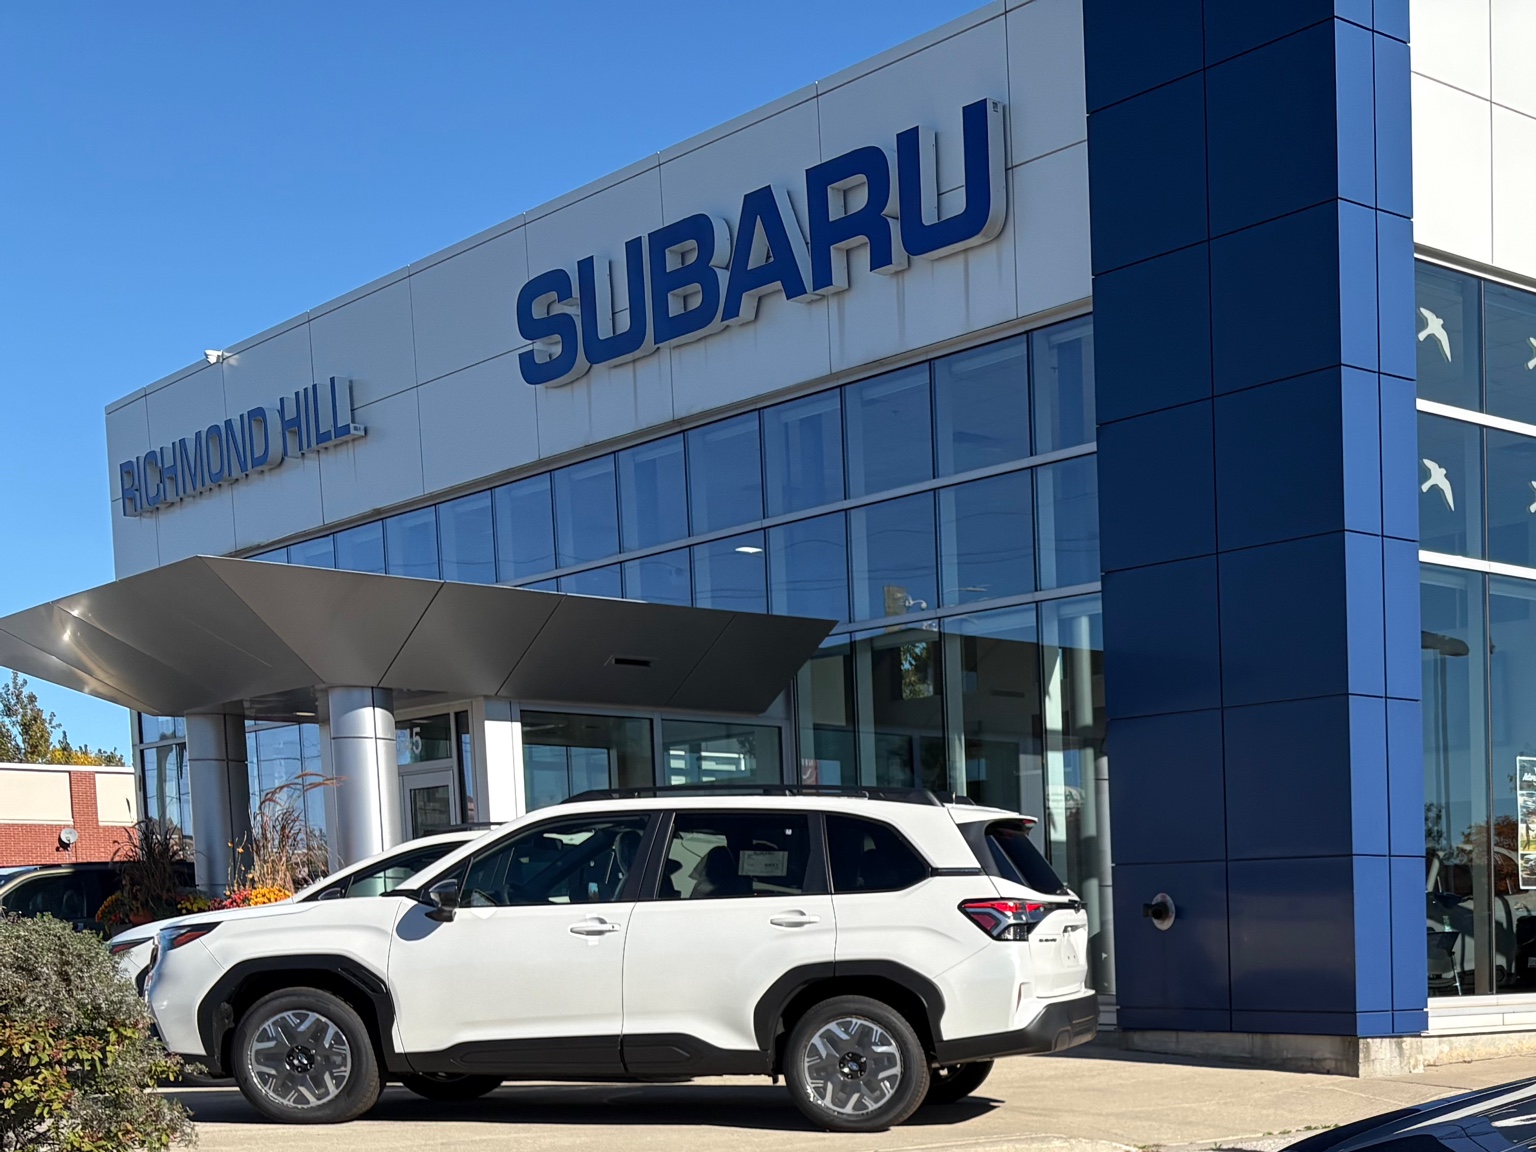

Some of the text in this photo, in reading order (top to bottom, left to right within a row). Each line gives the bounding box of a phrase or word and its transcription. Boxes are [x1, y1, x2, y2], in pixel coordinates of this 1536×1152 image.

[517, 97, 994, 386] SUBARU
[120, 376, 352, 517] RICHMOND HILL
